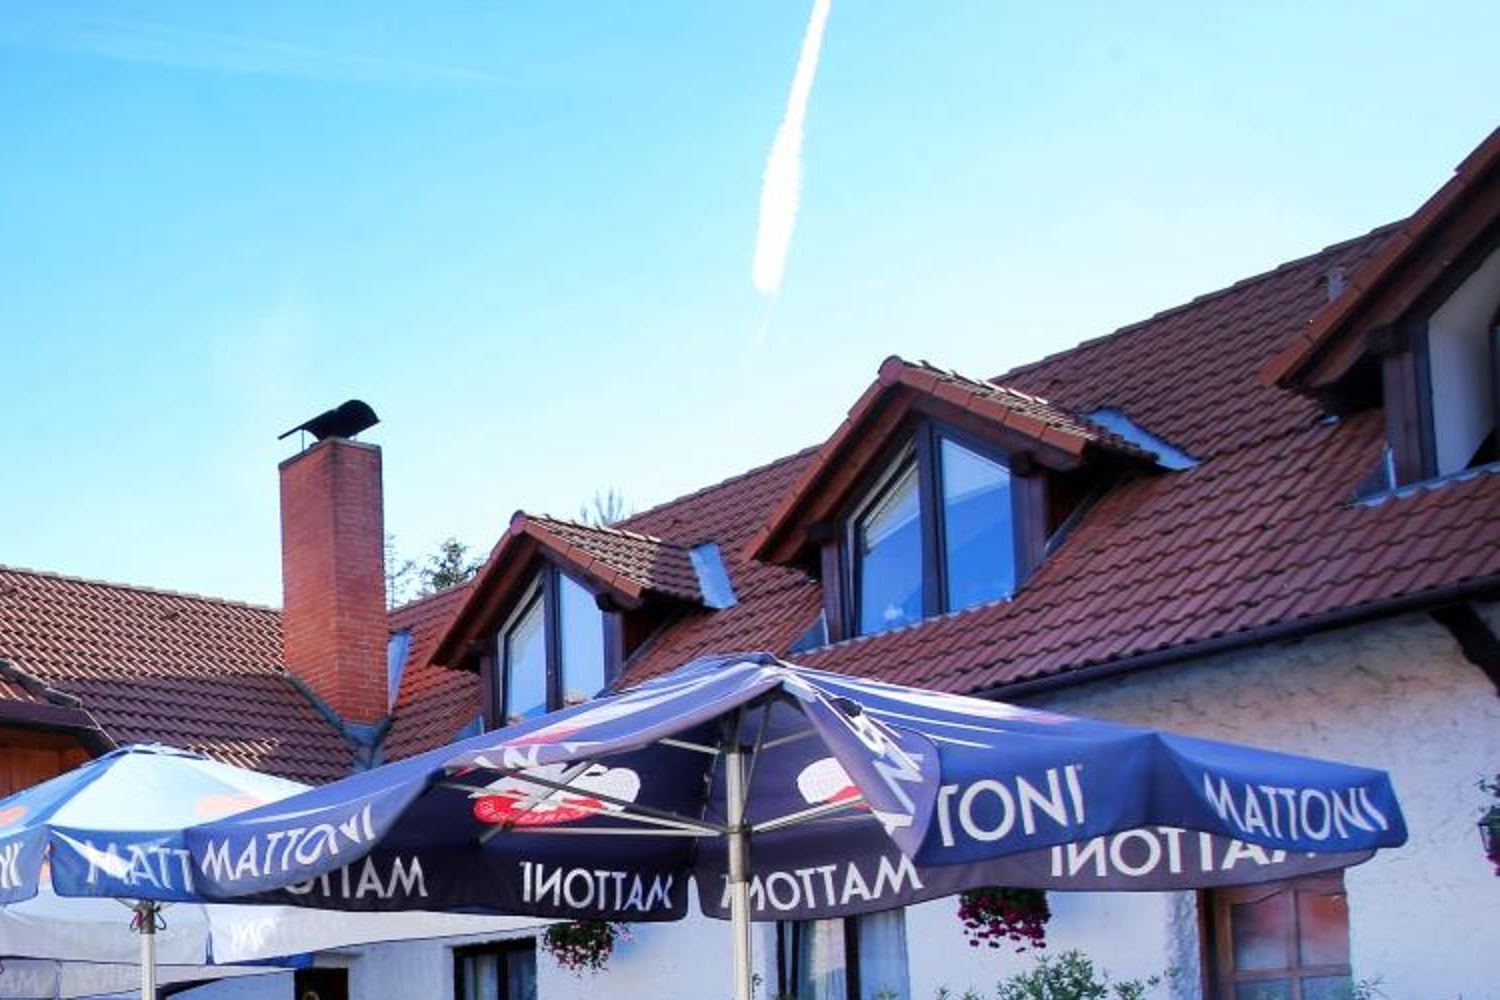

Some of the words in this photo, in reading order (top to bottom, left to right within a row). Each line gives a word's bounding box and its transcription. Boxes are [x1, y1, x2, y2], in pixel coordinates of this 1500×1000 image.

[937, 765, 1086, 848] TONI
[1203, 772, 1389, 841] MATTONI
[87, 841, 194, 894] MATT
[201, 805, 376, 881] MATTONI
